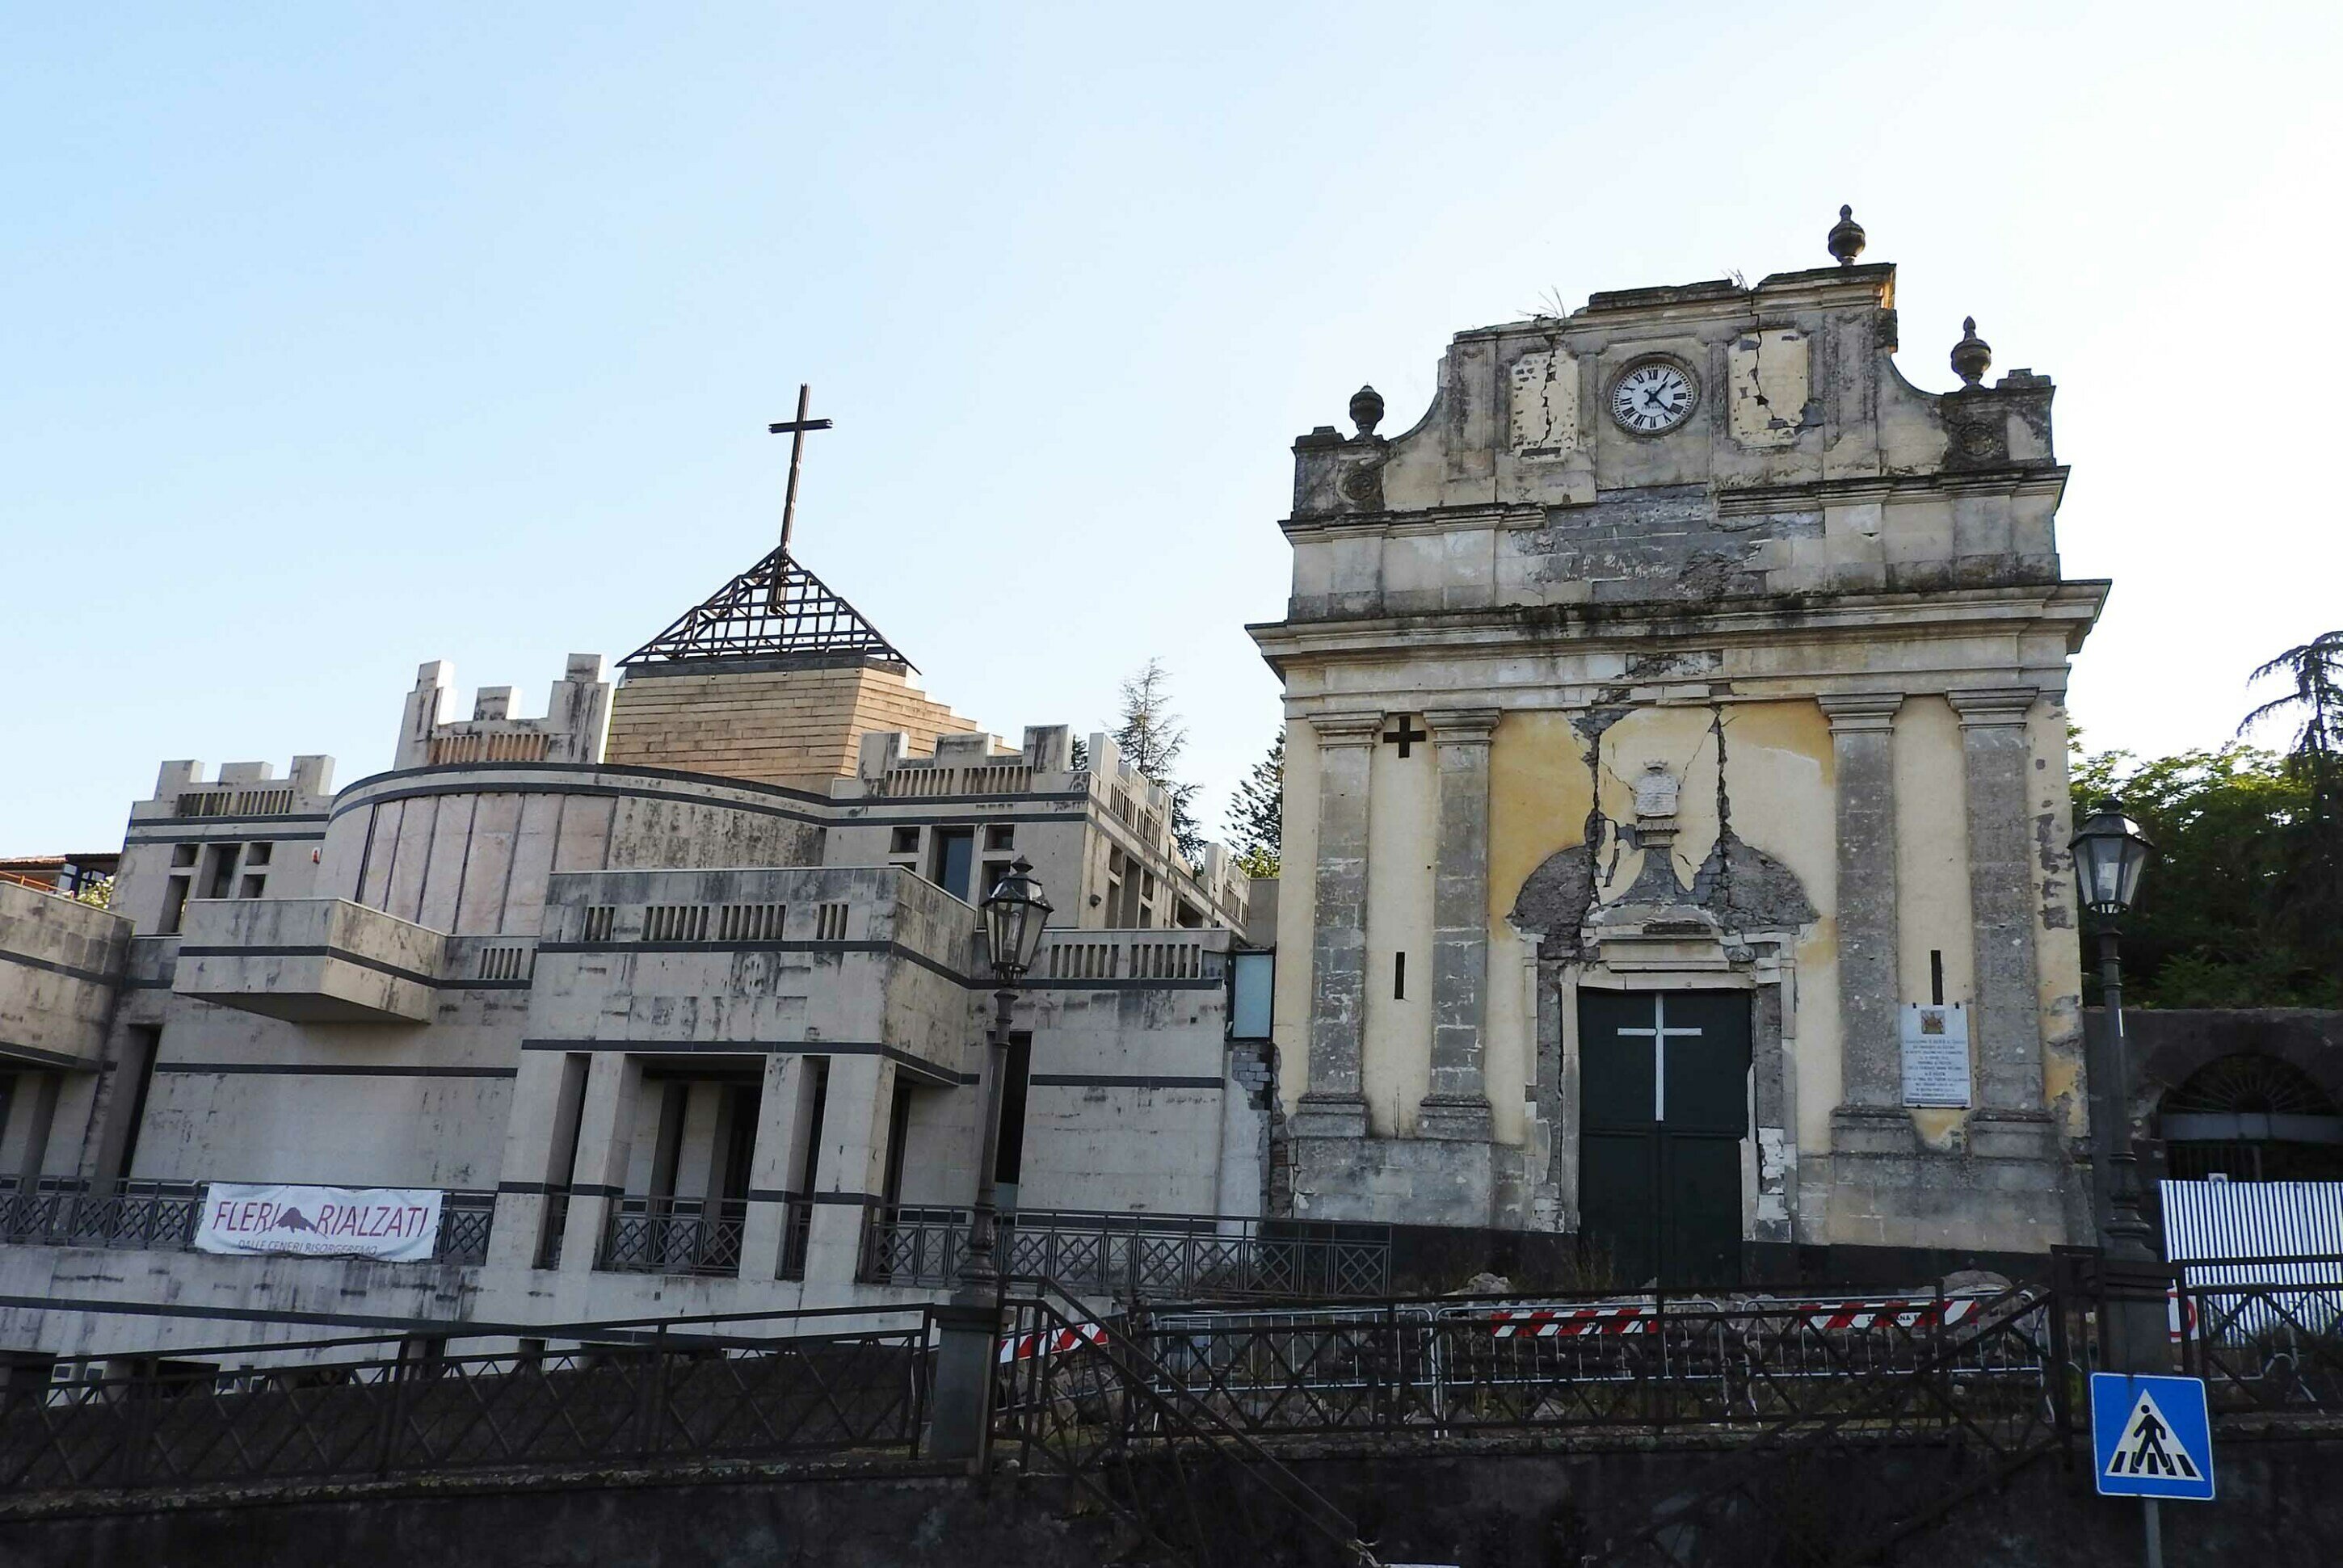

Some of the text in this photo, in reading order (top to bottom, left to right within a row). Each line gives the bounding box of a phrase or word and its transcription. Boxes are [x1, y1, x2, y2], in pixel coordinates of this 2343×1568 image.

[1647, 369, 1658, 380] XII
[1663, 372, 1670, 382] I
[212, 1201, 429, 1238] FLERI RIALZATI
[238, 1239, 378, 1255] DALLE CENERI RISORGEREMO
